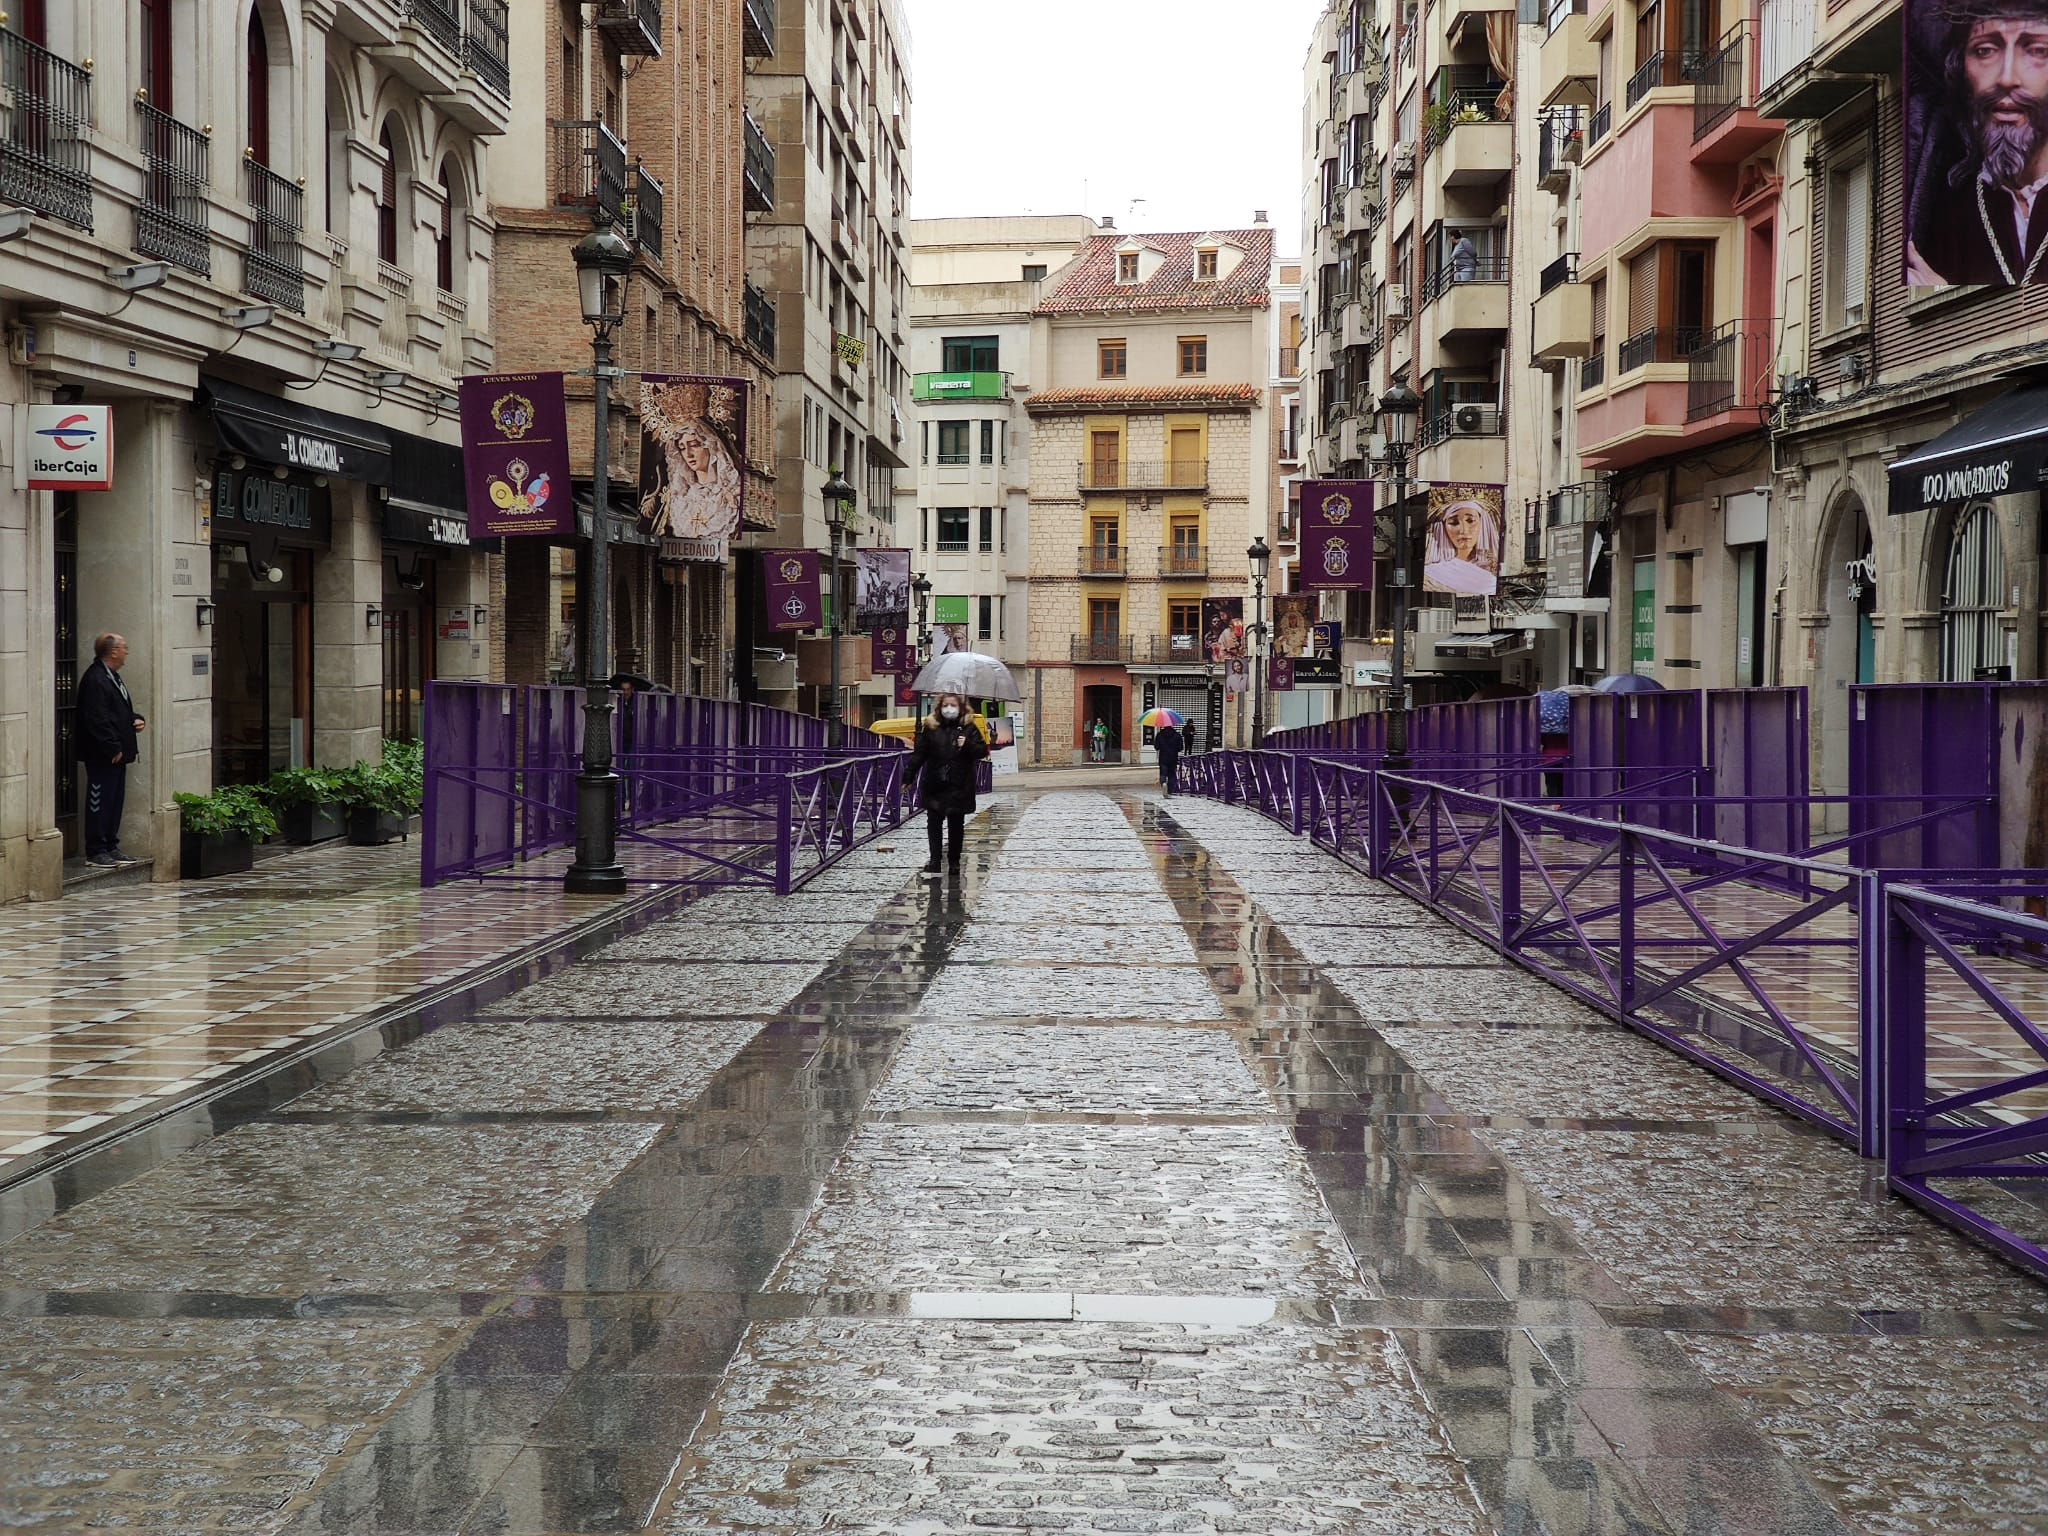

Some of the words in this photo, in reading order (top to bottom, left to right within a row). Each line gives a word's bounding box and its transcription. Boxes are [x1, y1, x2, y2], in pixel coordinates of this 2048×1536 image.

[287, 433, 299, 463] EL
[299, 436, 340, 472] COMERCIAL
[34, 459, 98, 476] iberCaja
[1922, 473, 1944, 504] 100
[1944, 461, 2010, 503] MONTADITOS
[217, 472, 235, 519] EL
[242, 476, 312, 529] COMERCIAL
[432, 518, 442, 542] EL
[665, 541, 716, 557] TOLEDANO
[1639, 606, 1653, 623] LOCAL
